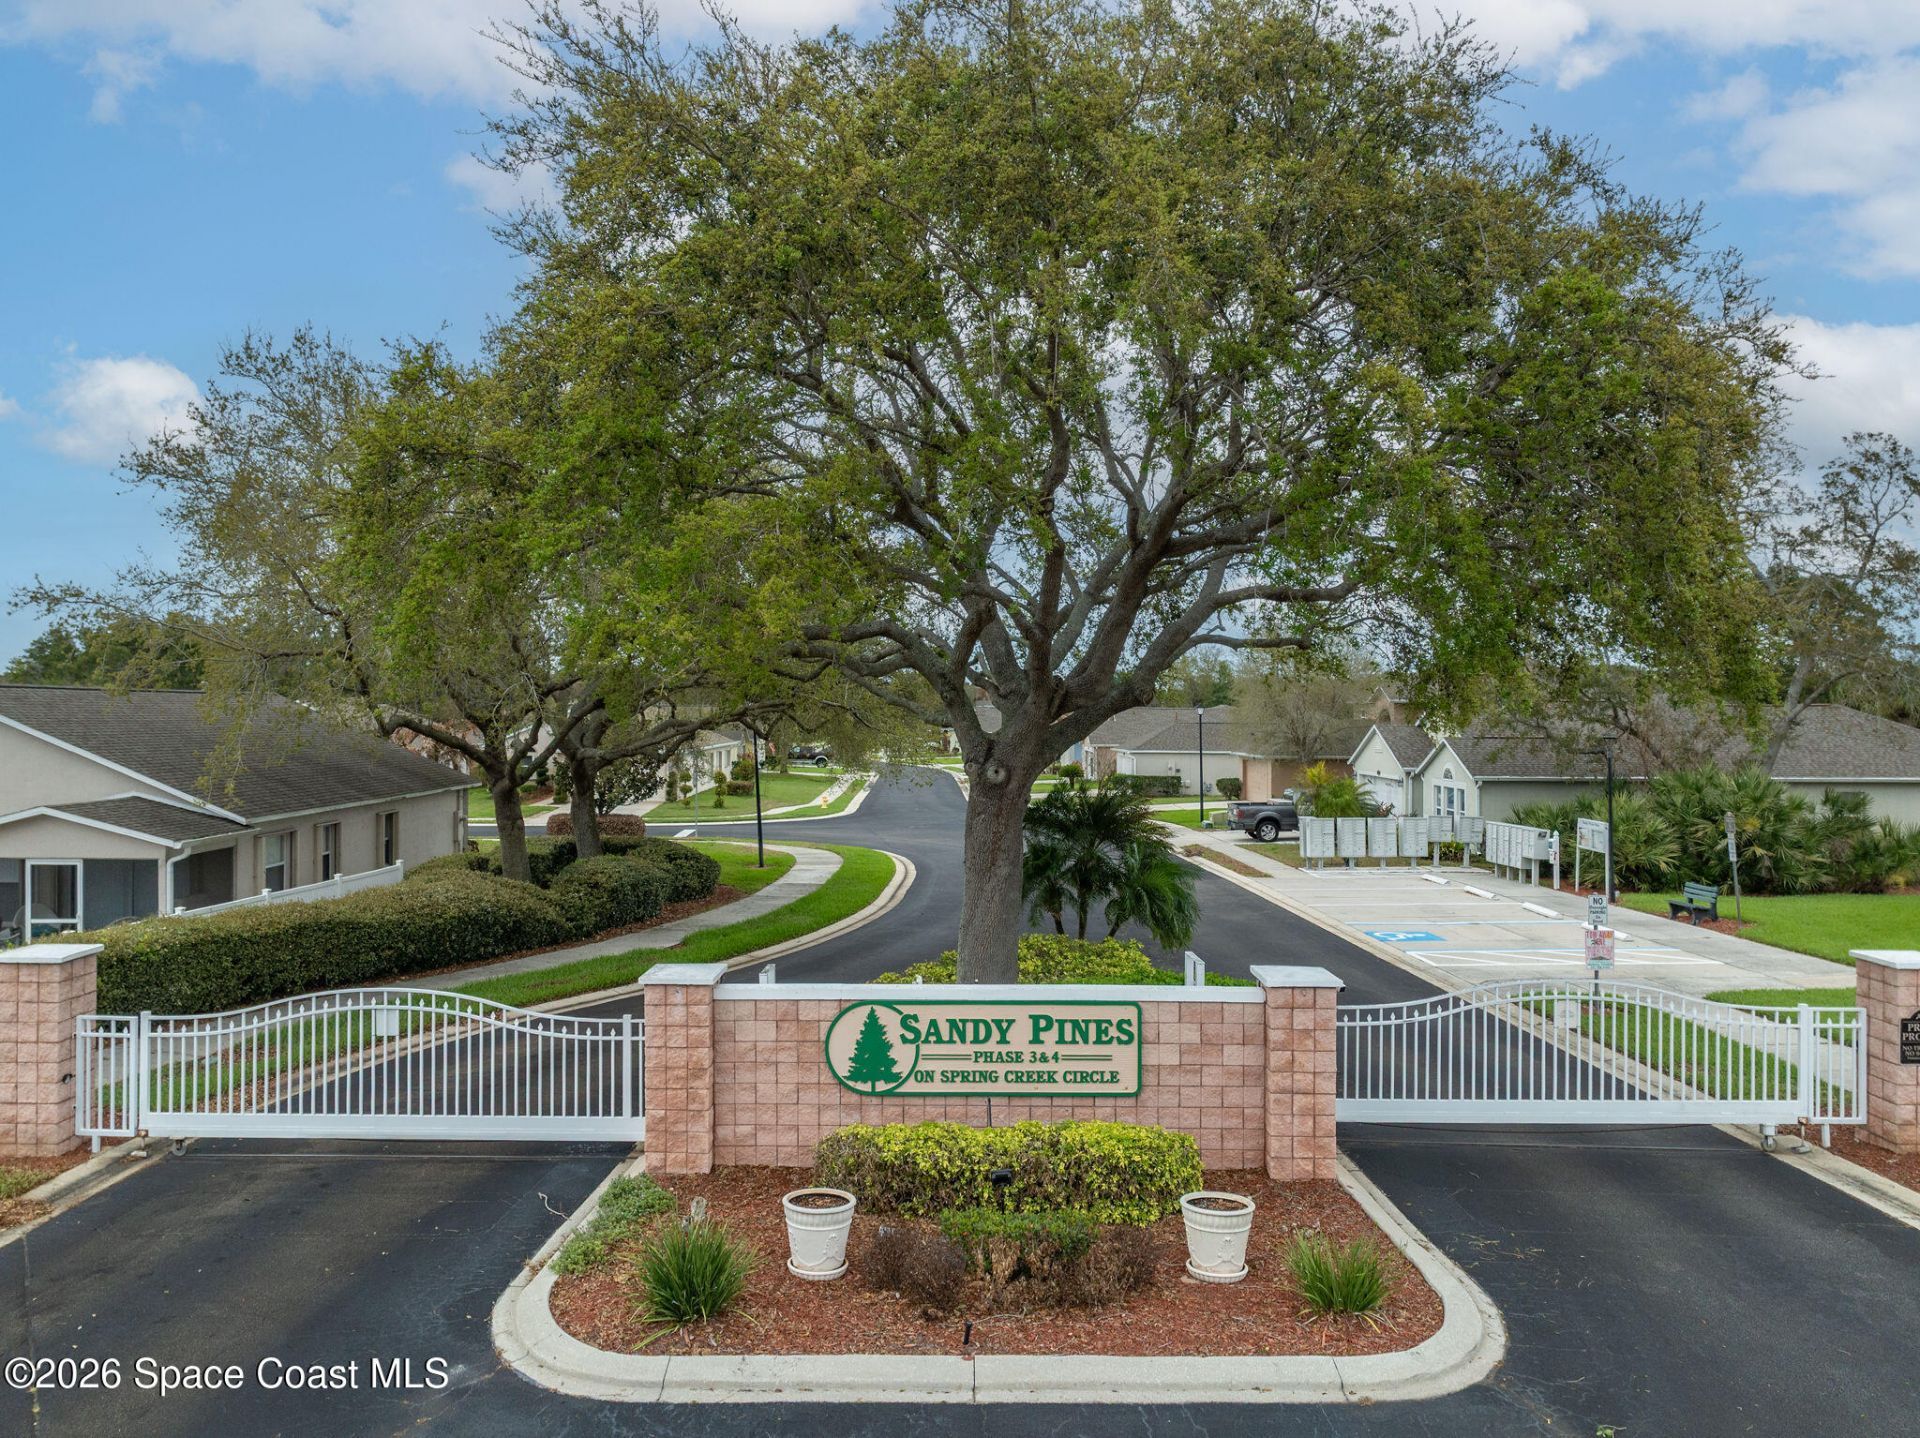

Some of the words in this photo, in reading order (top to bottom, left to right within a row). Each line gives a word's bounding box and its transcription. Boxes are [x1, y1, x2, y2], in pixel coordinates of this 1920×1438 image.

[1593, 897, 1603, 905] NO
[899, 1013, 1016, 1045] SANDY
[1028, 1013, 1135, 1045] PINES
[972, 1051, 1024, 1064] PHASE
[914, 1070, 934, 1083] ON
[940, 1070, 999, 1083] SPRING
[1004, 1070, 1057, 1083] CREEK
[1062, 1070, 1120, 1083] CIRCLE
